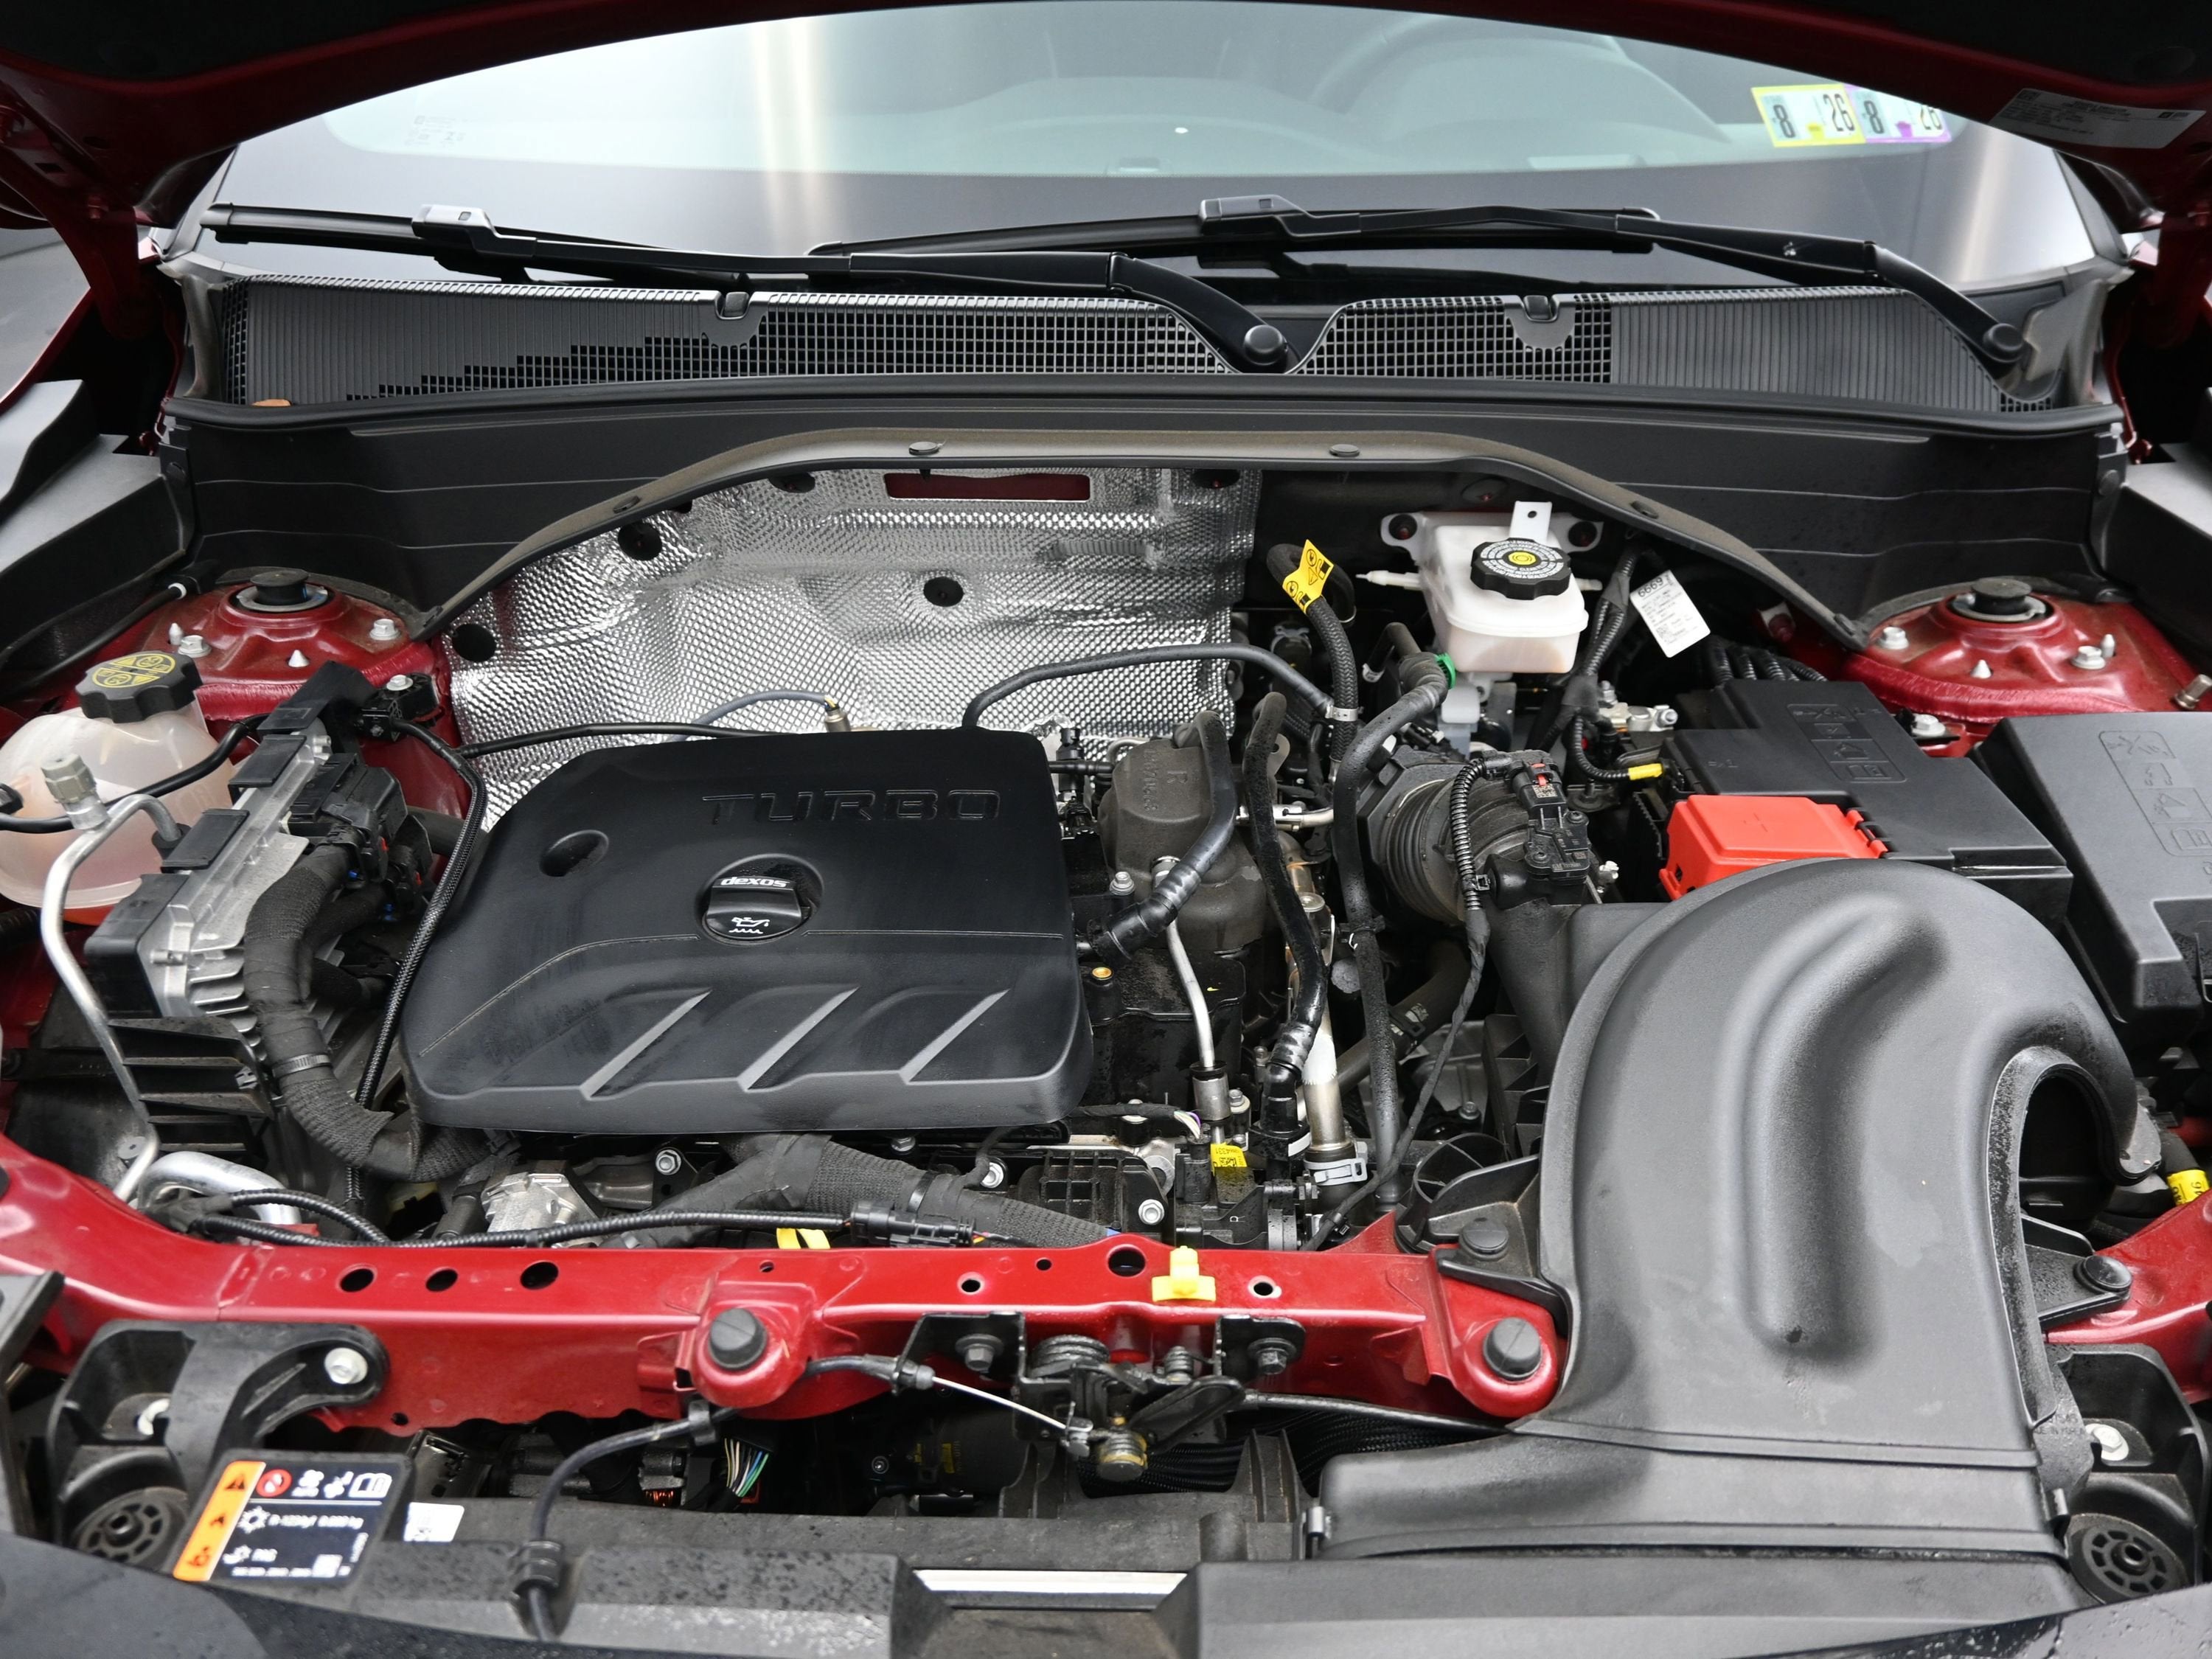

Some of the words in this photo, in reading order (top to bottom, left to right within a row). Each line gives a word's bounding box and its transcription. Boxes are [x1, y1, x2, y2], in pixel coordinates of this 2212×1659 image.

[1773, 104, 1796, 139] 8
[1823, 93, 1856, 132] 26
[1863, 100, 1885, 135] 8
[1638, 576, 1664, 597] 6669
[701, 789, 1001, 825] TURBO
[720, 876, 791, 888] dexos
